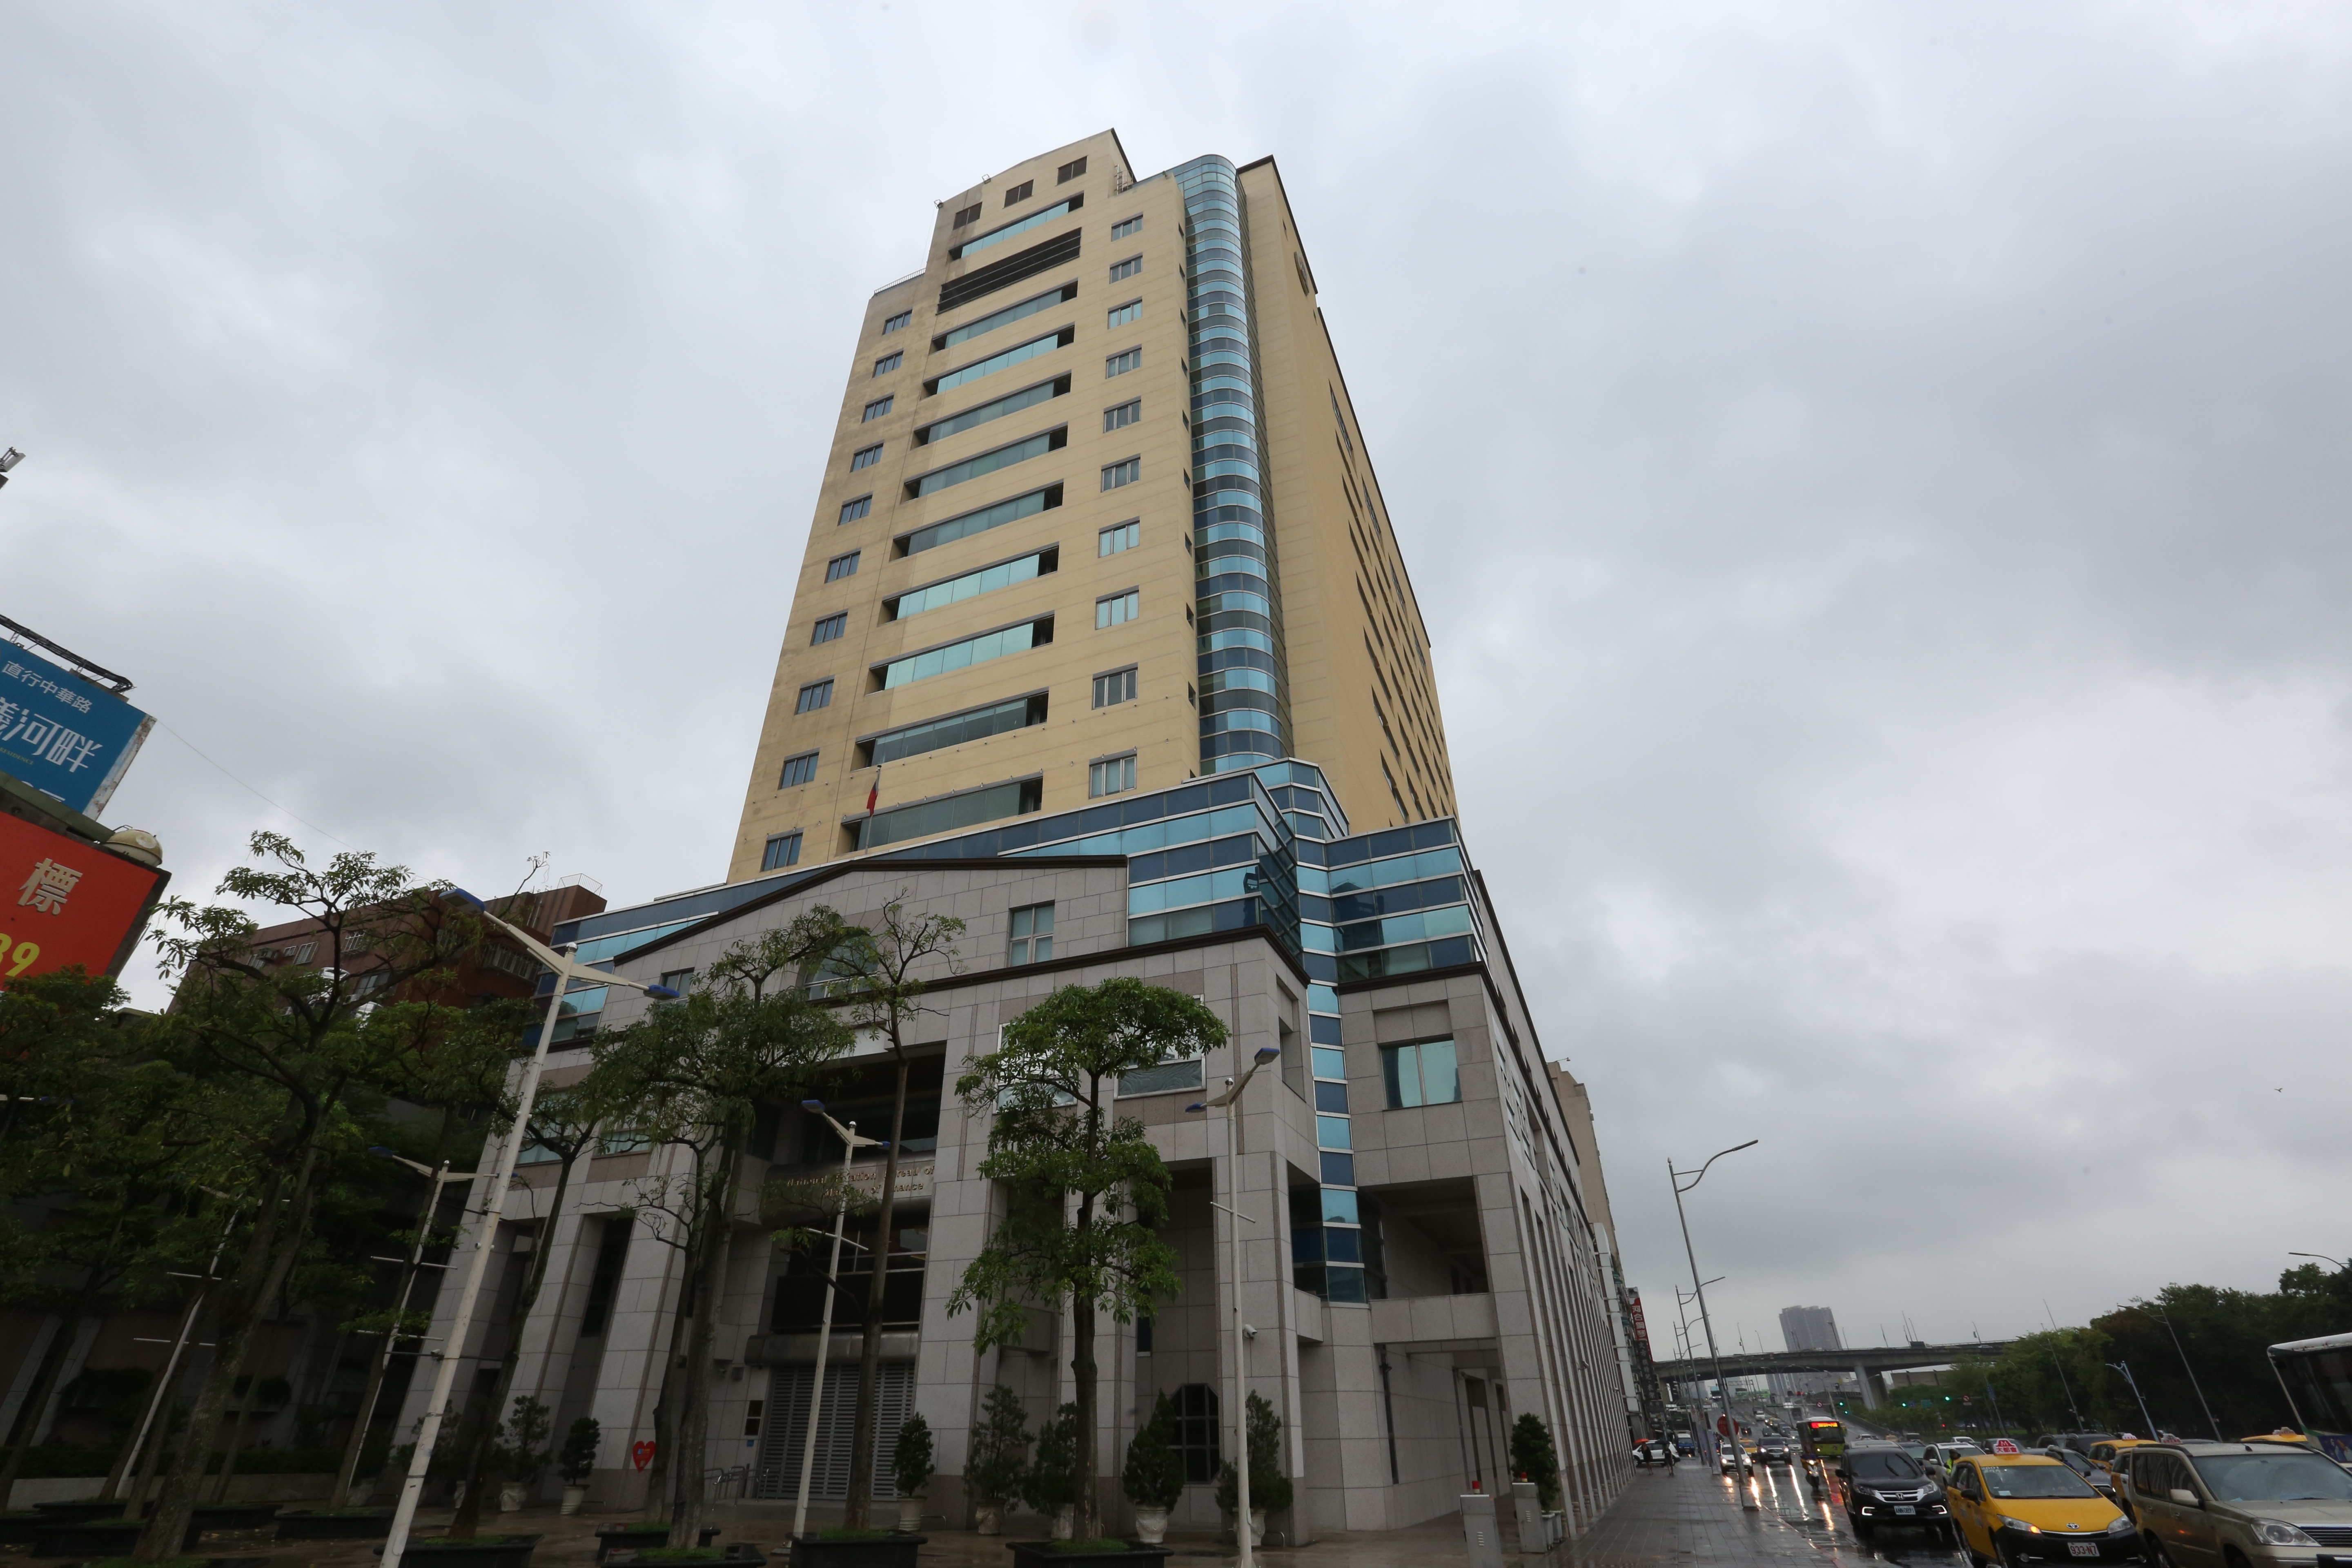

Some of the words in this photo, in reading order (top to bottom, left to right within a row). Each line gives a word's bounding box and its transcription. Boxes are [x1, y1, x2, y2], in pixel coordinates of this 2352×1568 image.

[2, 661, 92, 713] 直行中華路
[17, 858, 83, 915] 標
[924, 1165, 935, 1175] of
[871, 1185, 881, 1194] of
[2070, 1546, 2097, 1555] 933-N7
